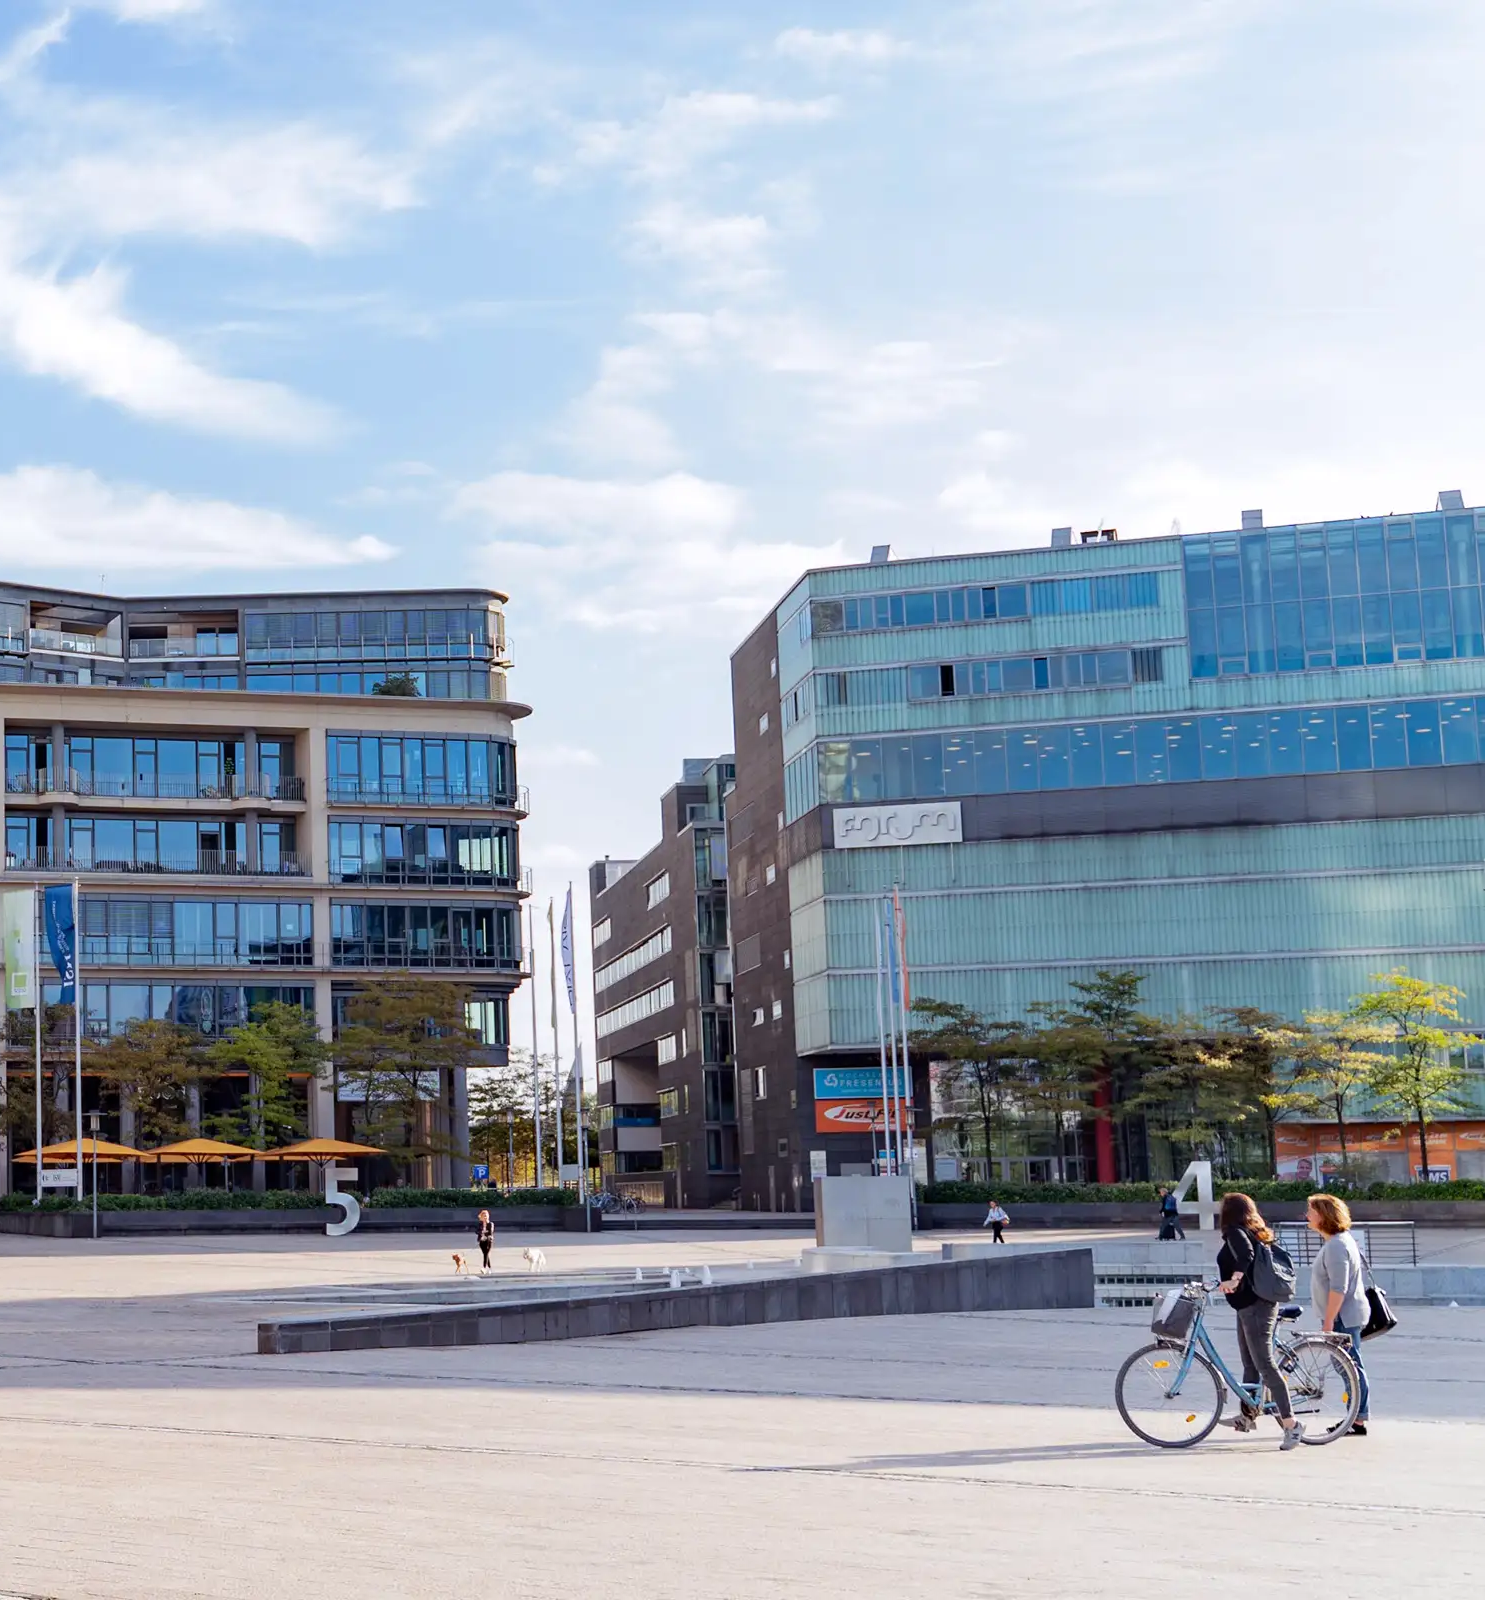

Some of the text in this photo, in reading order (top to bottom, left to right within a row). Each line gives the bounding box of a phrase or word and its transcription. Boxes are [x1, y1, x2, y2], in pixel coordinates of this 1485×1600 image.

[839, 1079, 903, 1087] FRESENUS
[325, 1167, 361, 1236] 5
[1171, 1160, 1221, 1231] 4
